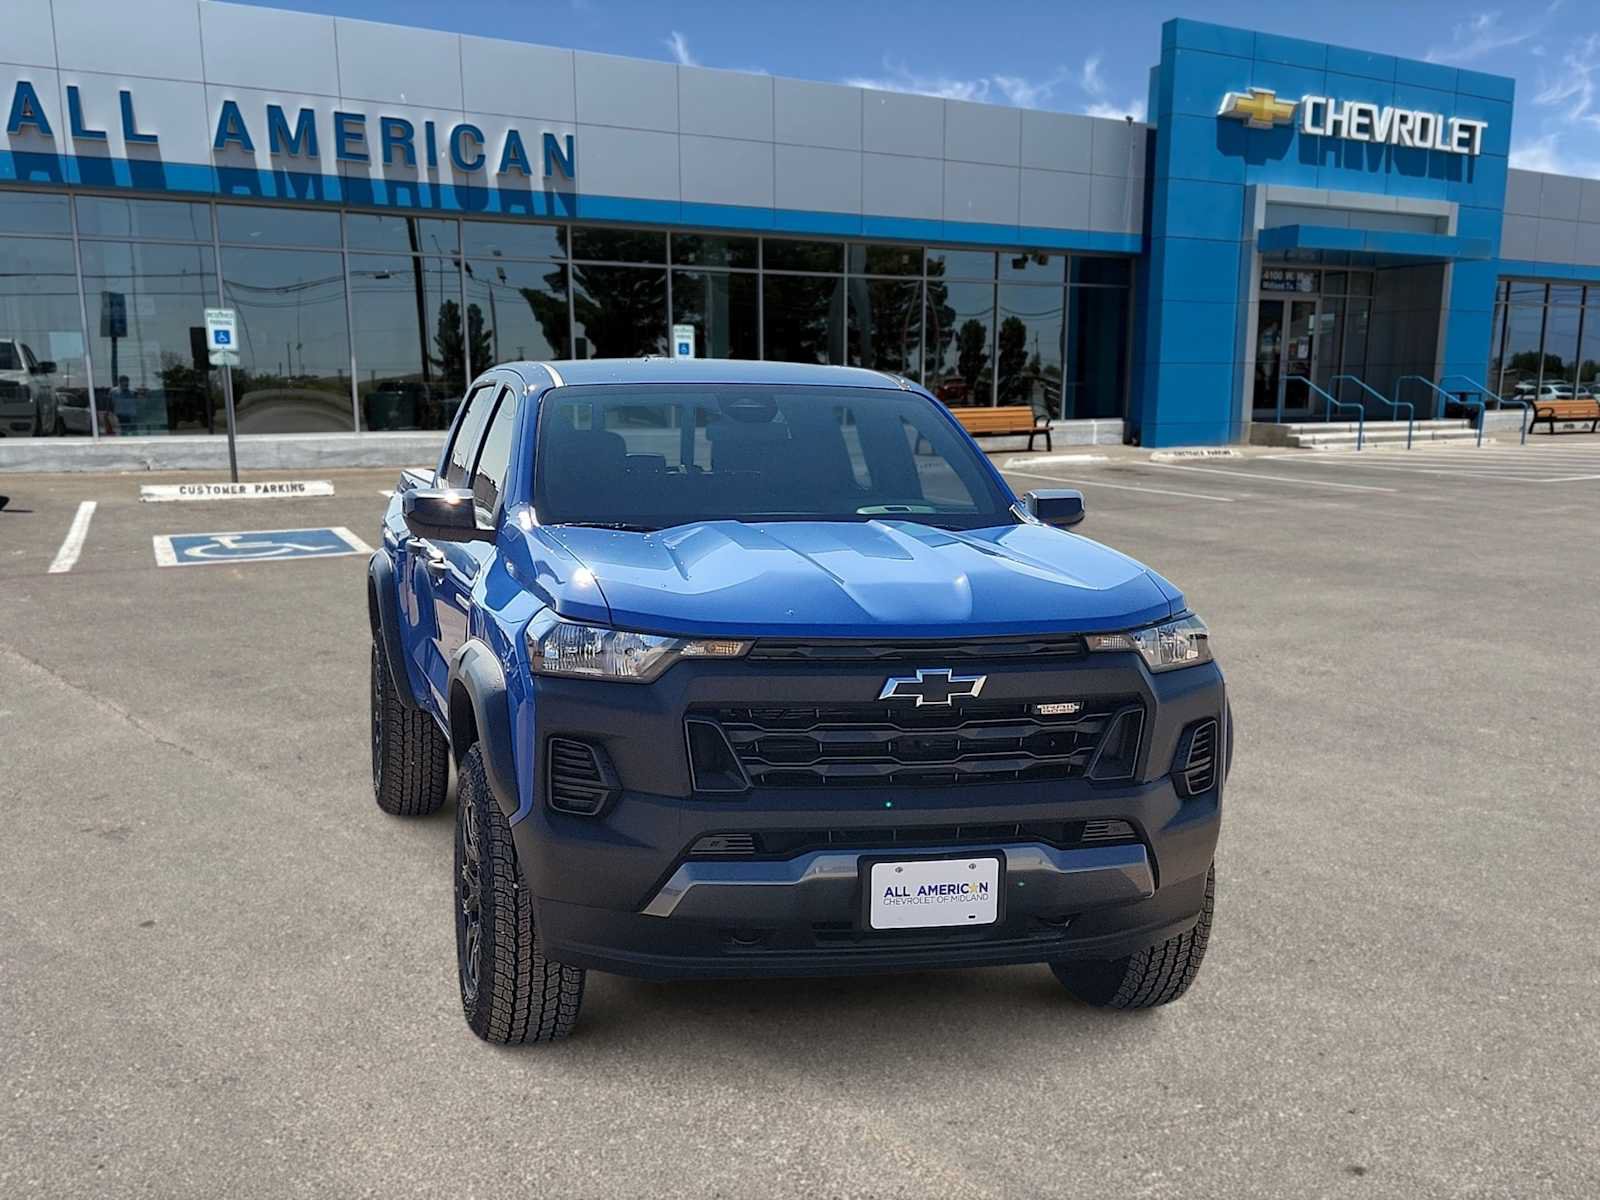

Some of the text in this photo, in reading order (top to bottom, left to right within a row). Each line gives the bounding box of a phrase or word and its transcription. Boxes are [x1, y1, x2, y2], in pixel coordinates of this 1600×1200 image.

[7, 80, 575, 178] ALL AMERICAN
[1302, 95, 1488, 155] CHEVROLET
[179, 483, 306, 496] CUSTOMER PARKING
[884, 886, 911, 898] ALL
[883, 893, 989, 906] CHEVROLET OF MIDLAND
